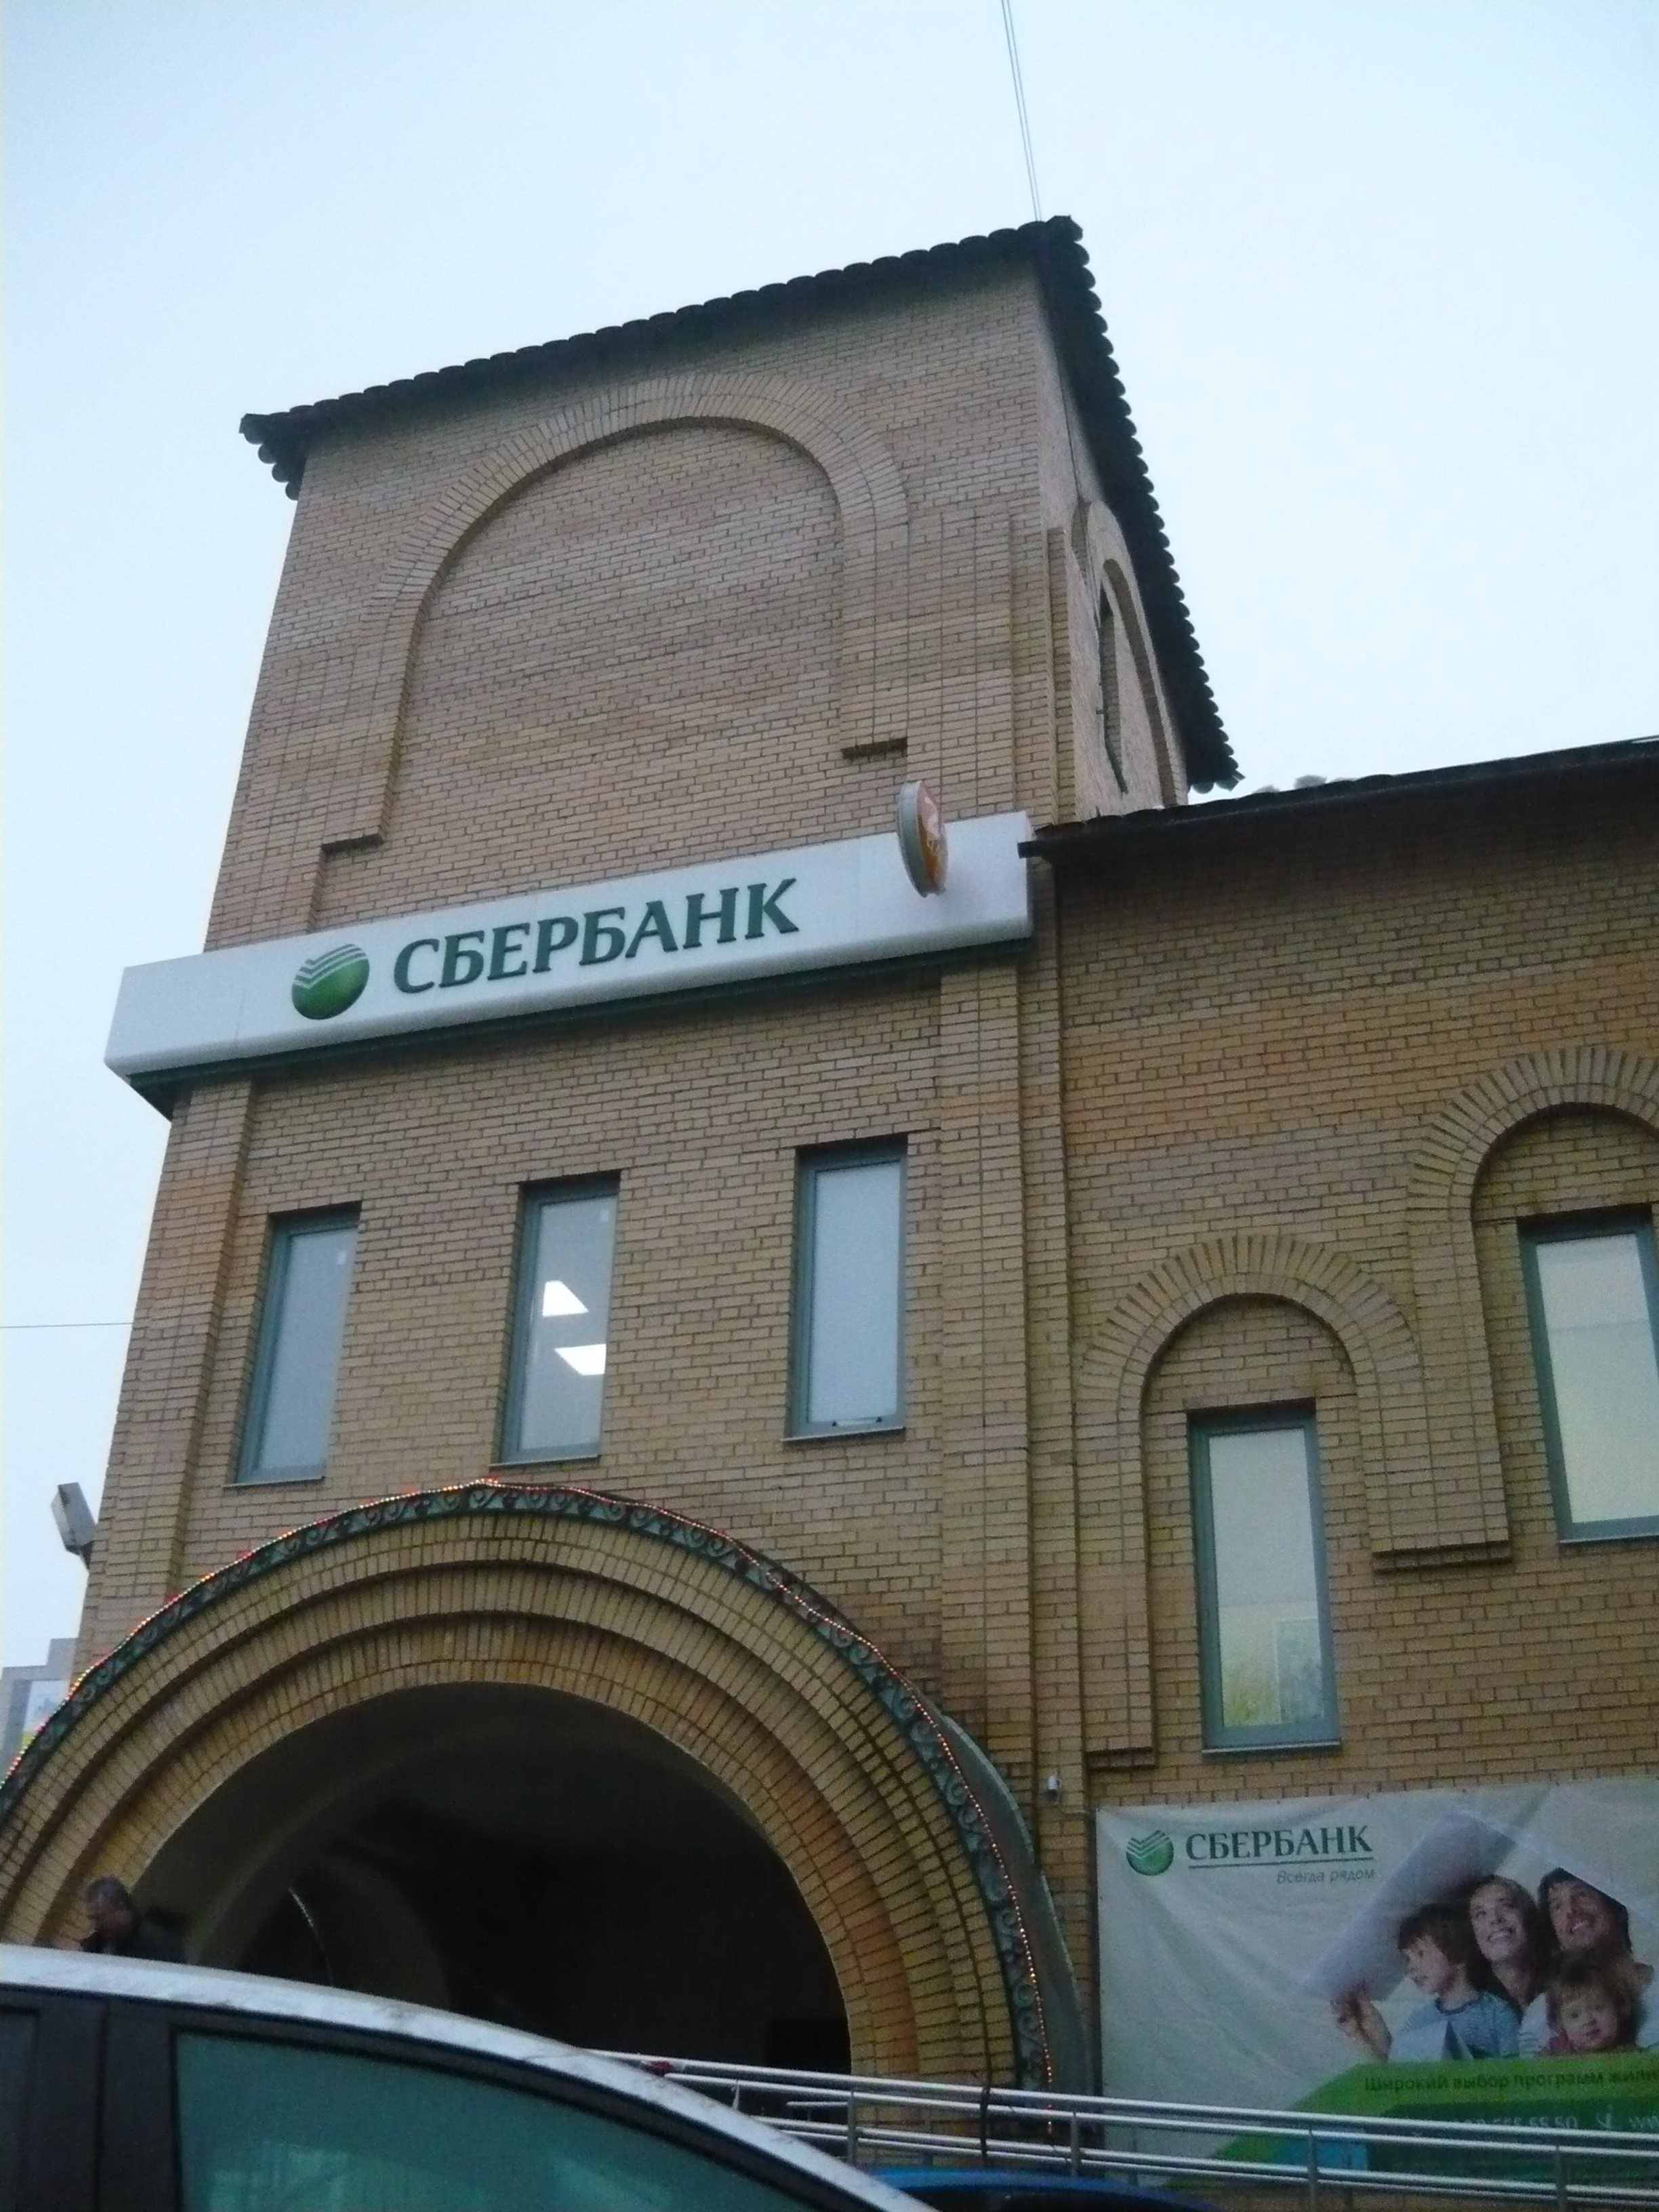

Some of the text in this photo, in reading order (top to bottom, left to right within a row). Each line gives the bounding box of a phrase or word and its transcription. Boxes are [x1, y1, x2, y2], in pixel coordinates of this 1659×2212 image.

[394, 878, 799, 994] СБЕРБАНК
[1186, 1825, 1372, 1860] СБЕРБАНК
[1277, 1869, 1375, 1884] Всегда рядом
[1364, 2074, 1448, 2093] Широкий
[1452, 2071, 1509, 2091] выбор
[1513, 2069, 1603, 2089] программ
